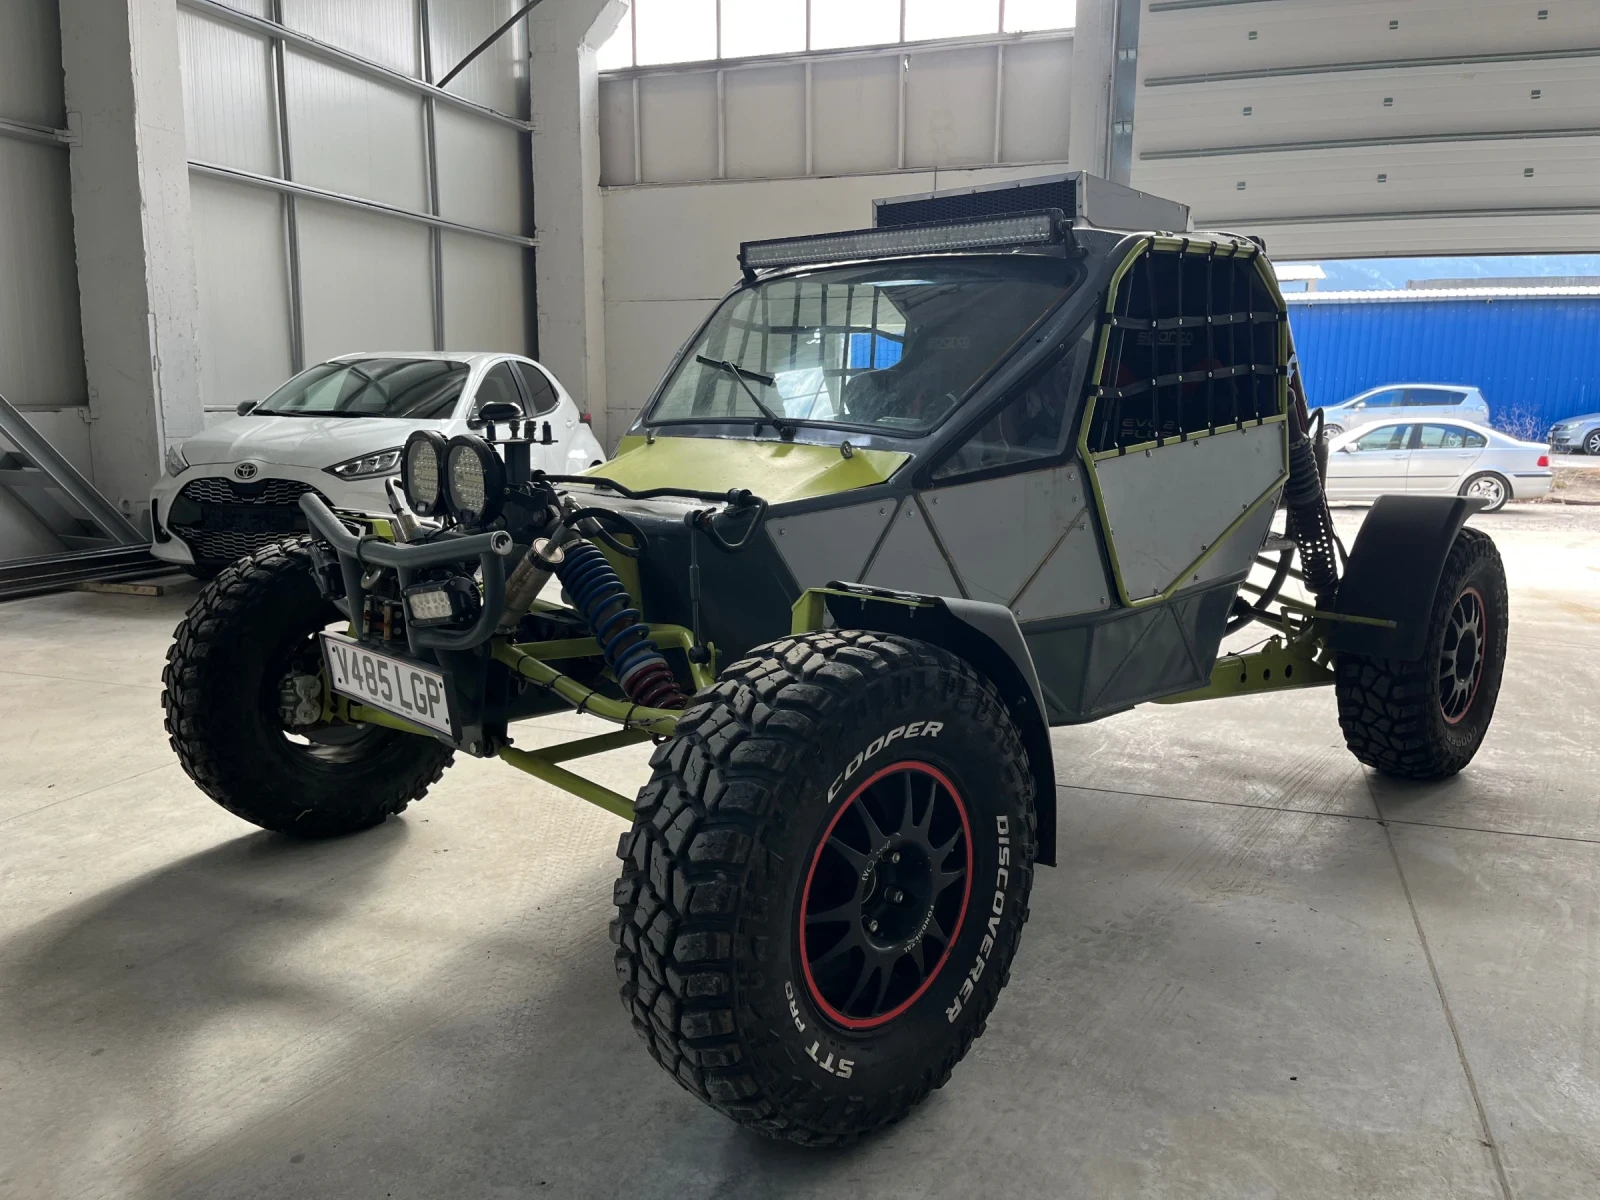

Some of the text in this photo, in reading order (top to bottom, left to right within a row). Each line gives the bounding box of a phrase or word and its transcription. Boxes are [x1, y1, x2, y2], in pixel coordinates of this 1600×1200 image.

[335, 646, 441, 718] V485 LGP
[827, 720, 944, 804] COOPER
[945, 815, 1010, 1024] DISCOVERER
[784, 980, 856, 1080] STT PRO
